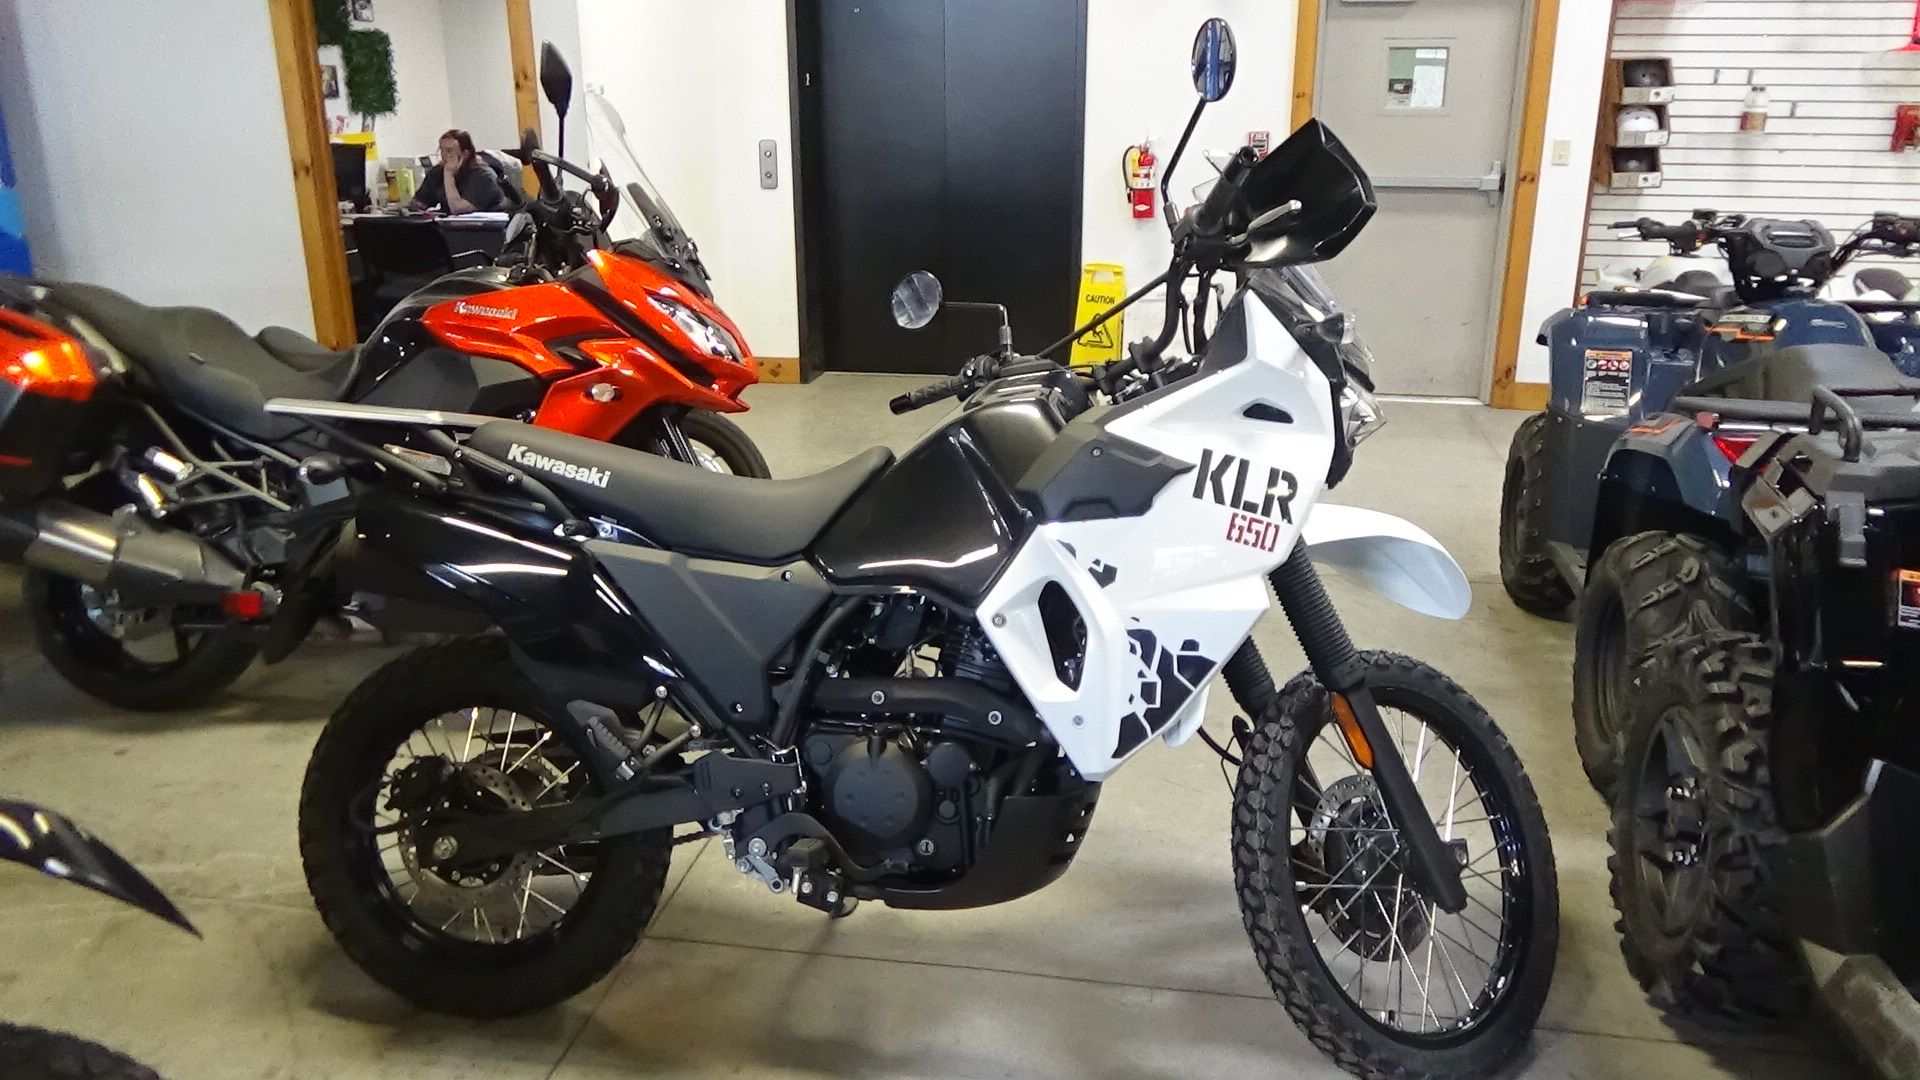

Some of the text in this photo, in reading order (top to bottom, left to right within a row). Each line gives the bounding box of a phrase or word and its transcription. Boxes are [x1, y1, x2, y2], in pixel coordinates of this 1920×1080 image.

[453, 300, 519, 320] Kawasaki
[1085, 294, 1116, 305] CAUTION
[507, 443, 612, 489] Kawasaki
[1192, 448, 1298, 525] KLR
[1226, 511, 1281, 553] 650
